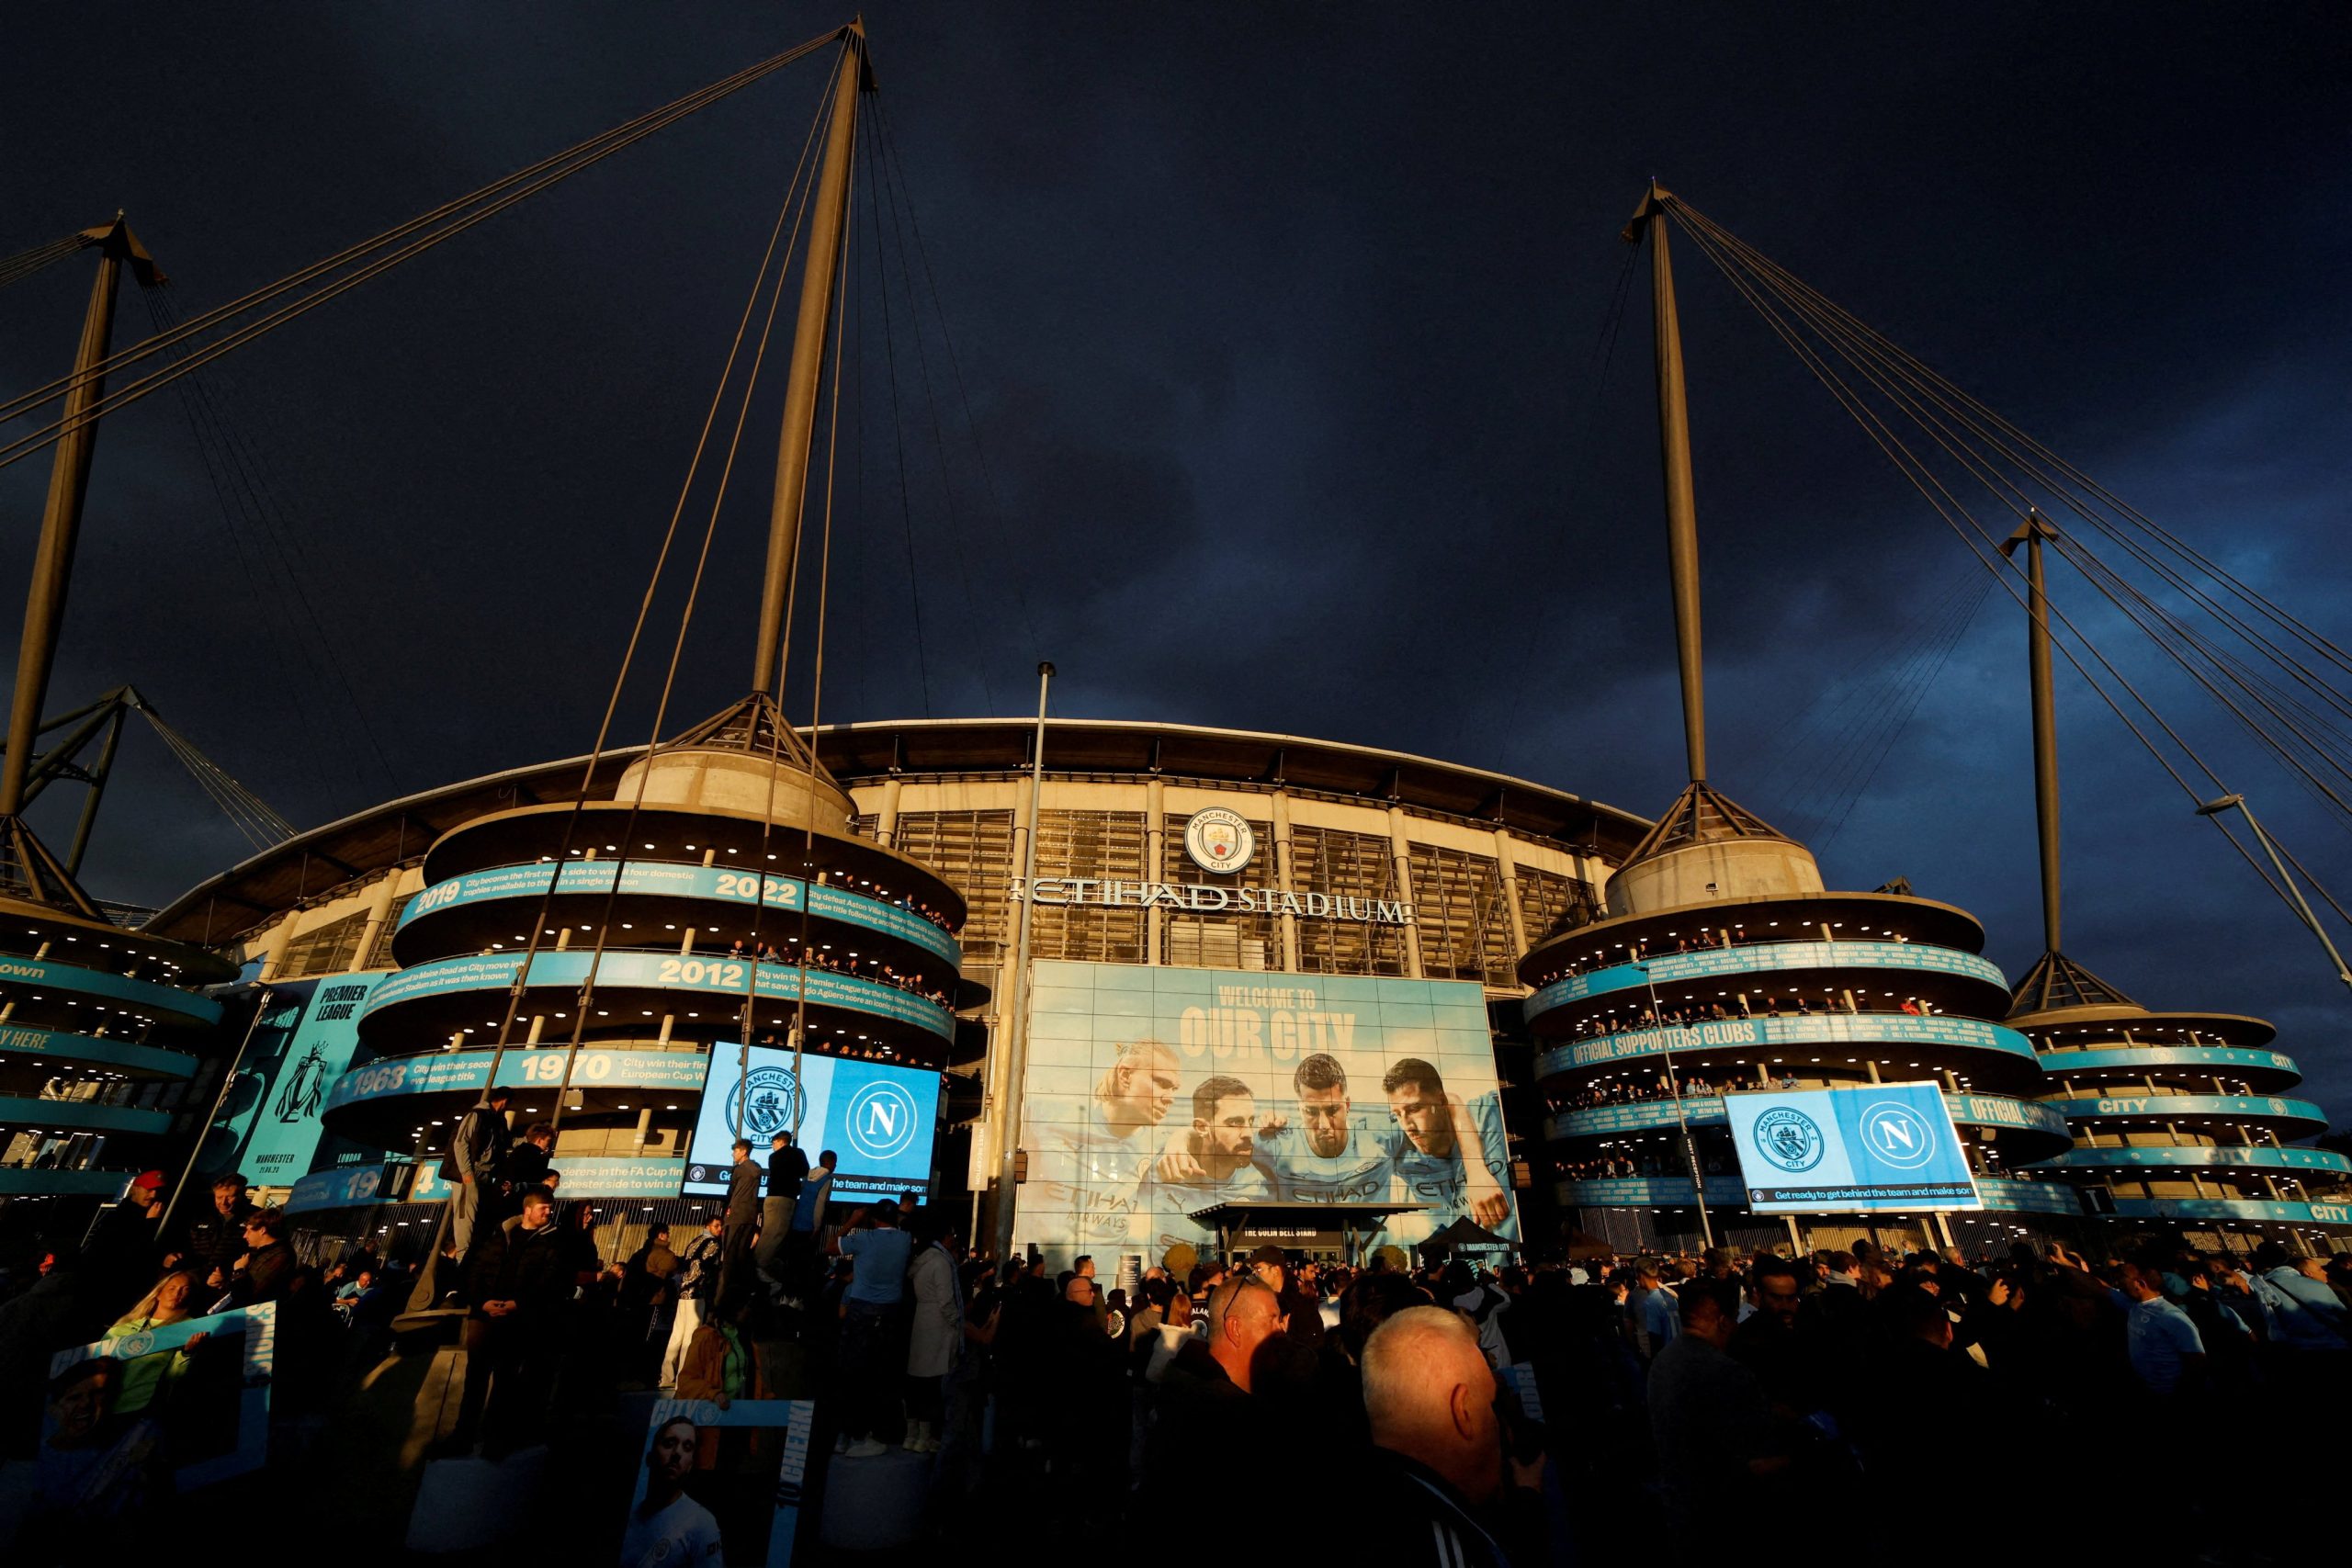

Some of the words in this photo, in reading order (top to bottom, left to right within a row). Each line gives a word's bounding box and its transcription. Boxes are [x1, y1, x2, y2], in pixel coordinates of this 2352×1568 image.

[1192, 812, 1248, 835] MANCHESTER
[463, 887, 491, 897] trophies
[492, 883, 526, 892] available
[577, 878, 604, 886] single
[466, 879, 481, 887] City
[481, 874, 509, 886] become
[510, 873, 523, 881] the
[524, 870, 541, 879] first
[415, 881, 460, 914] 2019
[715, 874, 797, 905] 2022
[822, 893, 846, 904] defeat
[847, 900, 867, 912] Aston
[868, 905, 882, 916] Villa
[1033, 878, 1228, 911] ETIHAD
[1239, 886, 1406, 924] STADIUM
[808, 902, 831, 912] eague
[833, 906, 847, 915] title
[848, 909, 877, 924] following
[419, 970, 438, 979] Maine
[439, 967, 457, 976] Road
[469, 964, 485, 973] City
[486, 962, 509, 970] move
[461, 975, 479, 983] then
[480, 973, 509, 981] known
[658, 959, 743, 988] 2012
[320, 985, 368, 1004] PREMIER
[754, 980, 771, 988] hat
[791, 985, 816, 996] Segio
[818, 988, 844, 999] Agüero
[845, 995, 864, 1004] score
[773, 972, 787, 981] win
[805, 976, 835, 988] Premier
[836, 981, 861, 994] League
[862, 987, 872, 996] for
[872, 988, 881, 998] the
[1218, 986, 1295, 1010] WELCOME
[1298, 988, 1316, 1010] TO
[315, 1003, 356, 1021] LEAGUE
[10, 1031, 51, 1049] HERE
[1180, 1006, 1264, 1059] OUR
[1271, 1010, 1356, 1063] CITY
[1573, 1041, 1616, 1065] OFFICIAL
[1616, 1024, 1700, 1056] SUPPORTERS
[1703, 1022, 1756, 1046] CLUBS
[413, 1065, 429, 1074] City
[431, 1063, 446, 1071] win
[447, 1061, 467, 1070] their
[521, 1054, 611, 1081] 1970
[624, 1058, 644, 1068] City
[647, 1059, 665, 1067] win
[668, 1059, 691, 1068] their
[2271, 1054, 2294, 1069] CITY
[353, 1065, 407, 1097] 1968
[428, 1074, 456, 1085] league
[458, 1072, 475, 1081] title
[621, 1069, 670, 1080] European
[673, 1071, 693, 1081] Cup
[1970, 1098, 2026, 1124] OFFICIAL
[2098, 1099, 2147, 1112] CITY
[865, 1101, 899, 1137] N
[1759, 1111, 1812, 1133] MANCHESTER
[750, 1134, 774, 1143] CITY
[1879, 1120, 1914, 1149] N
[255, 1154, 295, 1164] MANCHESTER
[2204, 1149, 2252, 1163] CITY
[390, 1166, 409, 1195] V
[599, 1167, 608, 1177] in
[611, 1167, 628, 1176] the
[630, 1168, 644, 1176] FA
[646, 1168, 667, 1179] Cup
[719, 1171, 731, 1181] Ge
[832, 1178, 844, 1187] he
[845, 1180, 868, 1190] team
[871, 1179, 886, 1190] and
[887, 1181, 910, 1191] make
[1416, 1160, 1503, 1197] ETIHD
[1690, 1156, 1702, 1189] RECEPTION
[606, 1179, 628, 1189] side
[630, 1180, 642, 1189] to
[644, 1180, 664, 1189] win
[1775, 1190, 1790, 1200] Get
[1791, 1190, 1815, 1201] ready
[1815, 1190, 1826, 1199] to
[1826, 1190, 1839, 1201] get
[1840, 1189, 1870, 1198] behind
[1871, 1188, 1886, 1197] the
[1887, 1189, 1908, 1197] team
[1909, 1187, 1928, 1196] and
[1928, 1186, 1953, 1196] make
[2086, 1190, 2100, 1212] T
[1067, 1211, 1126, 1229] AIRWAYS
[2311, 1205, 2348, 1221] CITY
[1244, 1227, 1257, 1237] THE
[1258, 1227, 1278, 1237] COLIN
[1279, 1227, 1295, 1237] BELL
[1295, 1227, 1317, 1237] STAND
[1467, 1243, 1498, 1252] MANCHESTER
